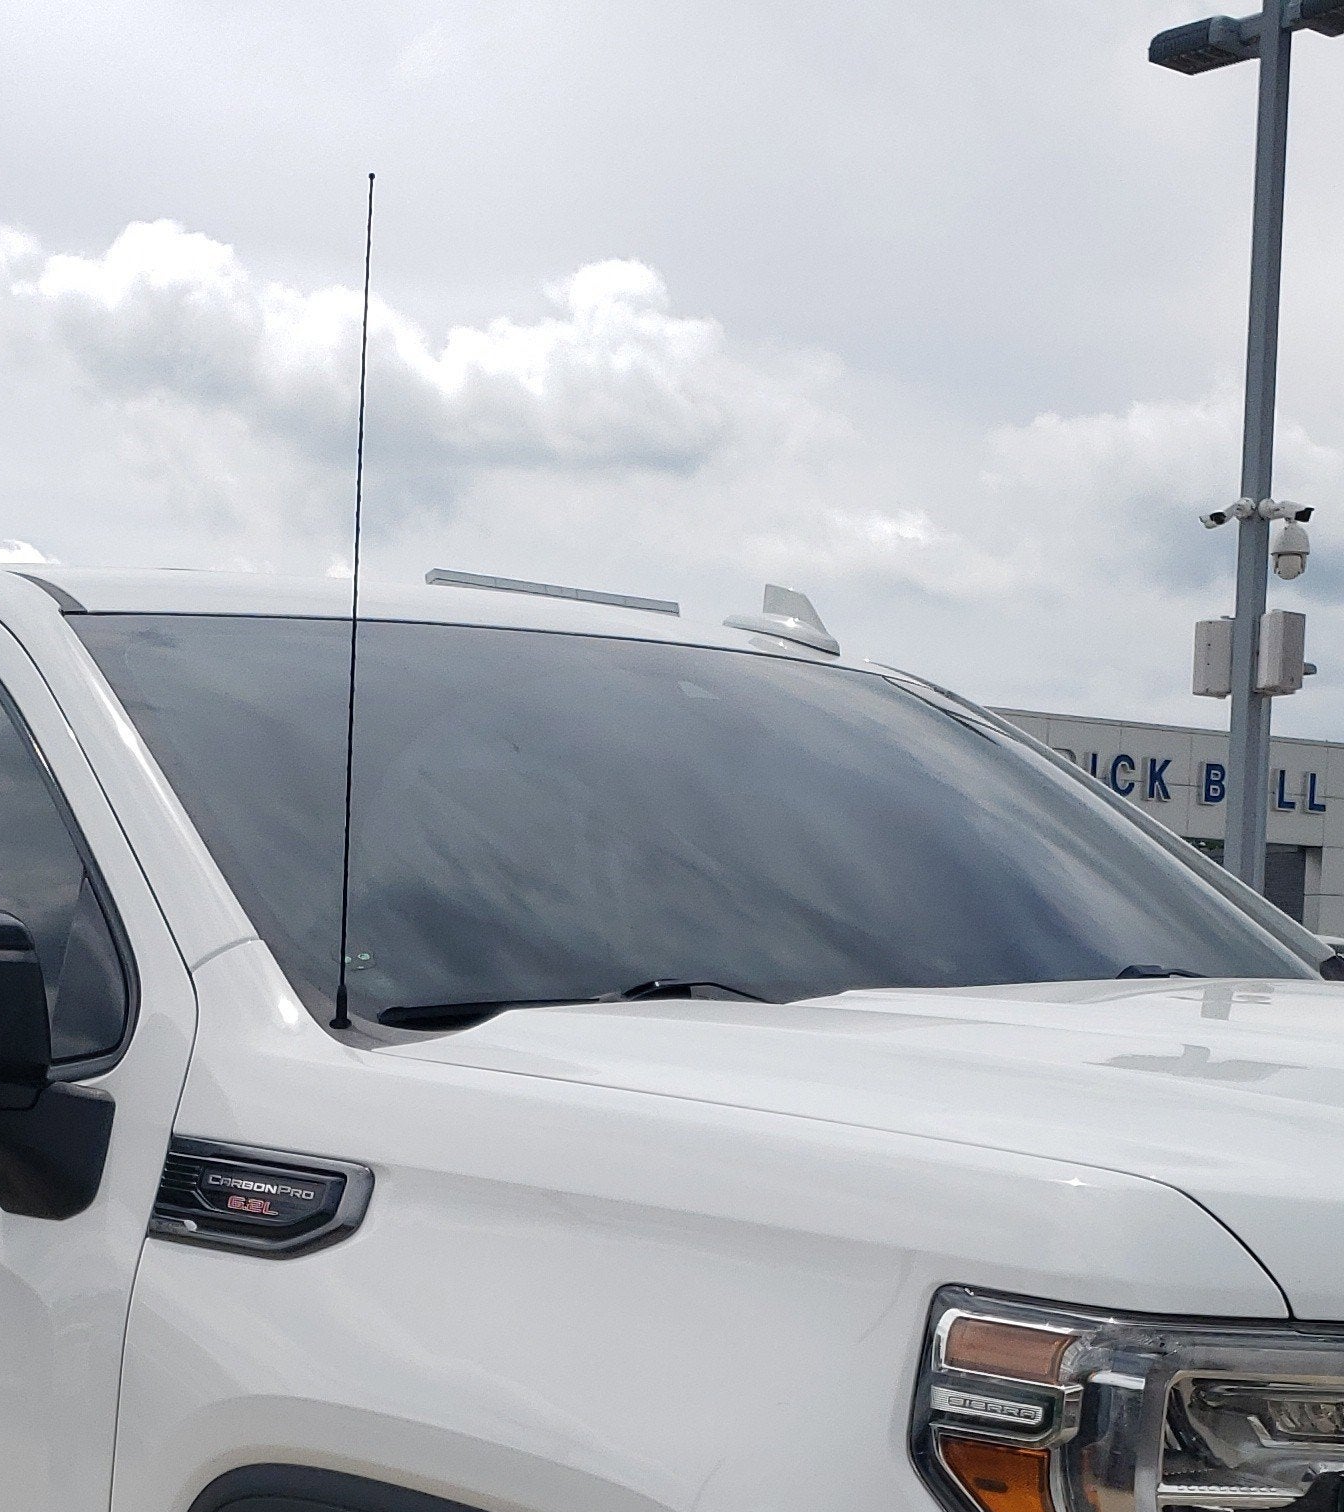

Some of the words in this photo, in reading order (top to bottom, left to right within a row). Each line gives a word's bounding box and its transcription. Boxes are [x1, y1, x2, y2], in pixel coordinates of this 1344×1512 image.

[1200, 762, 1327, 813] BLL
[227, 1195, 280, 1216] 6.2L
[947, 1396, 1038, 1421] SIERRA
